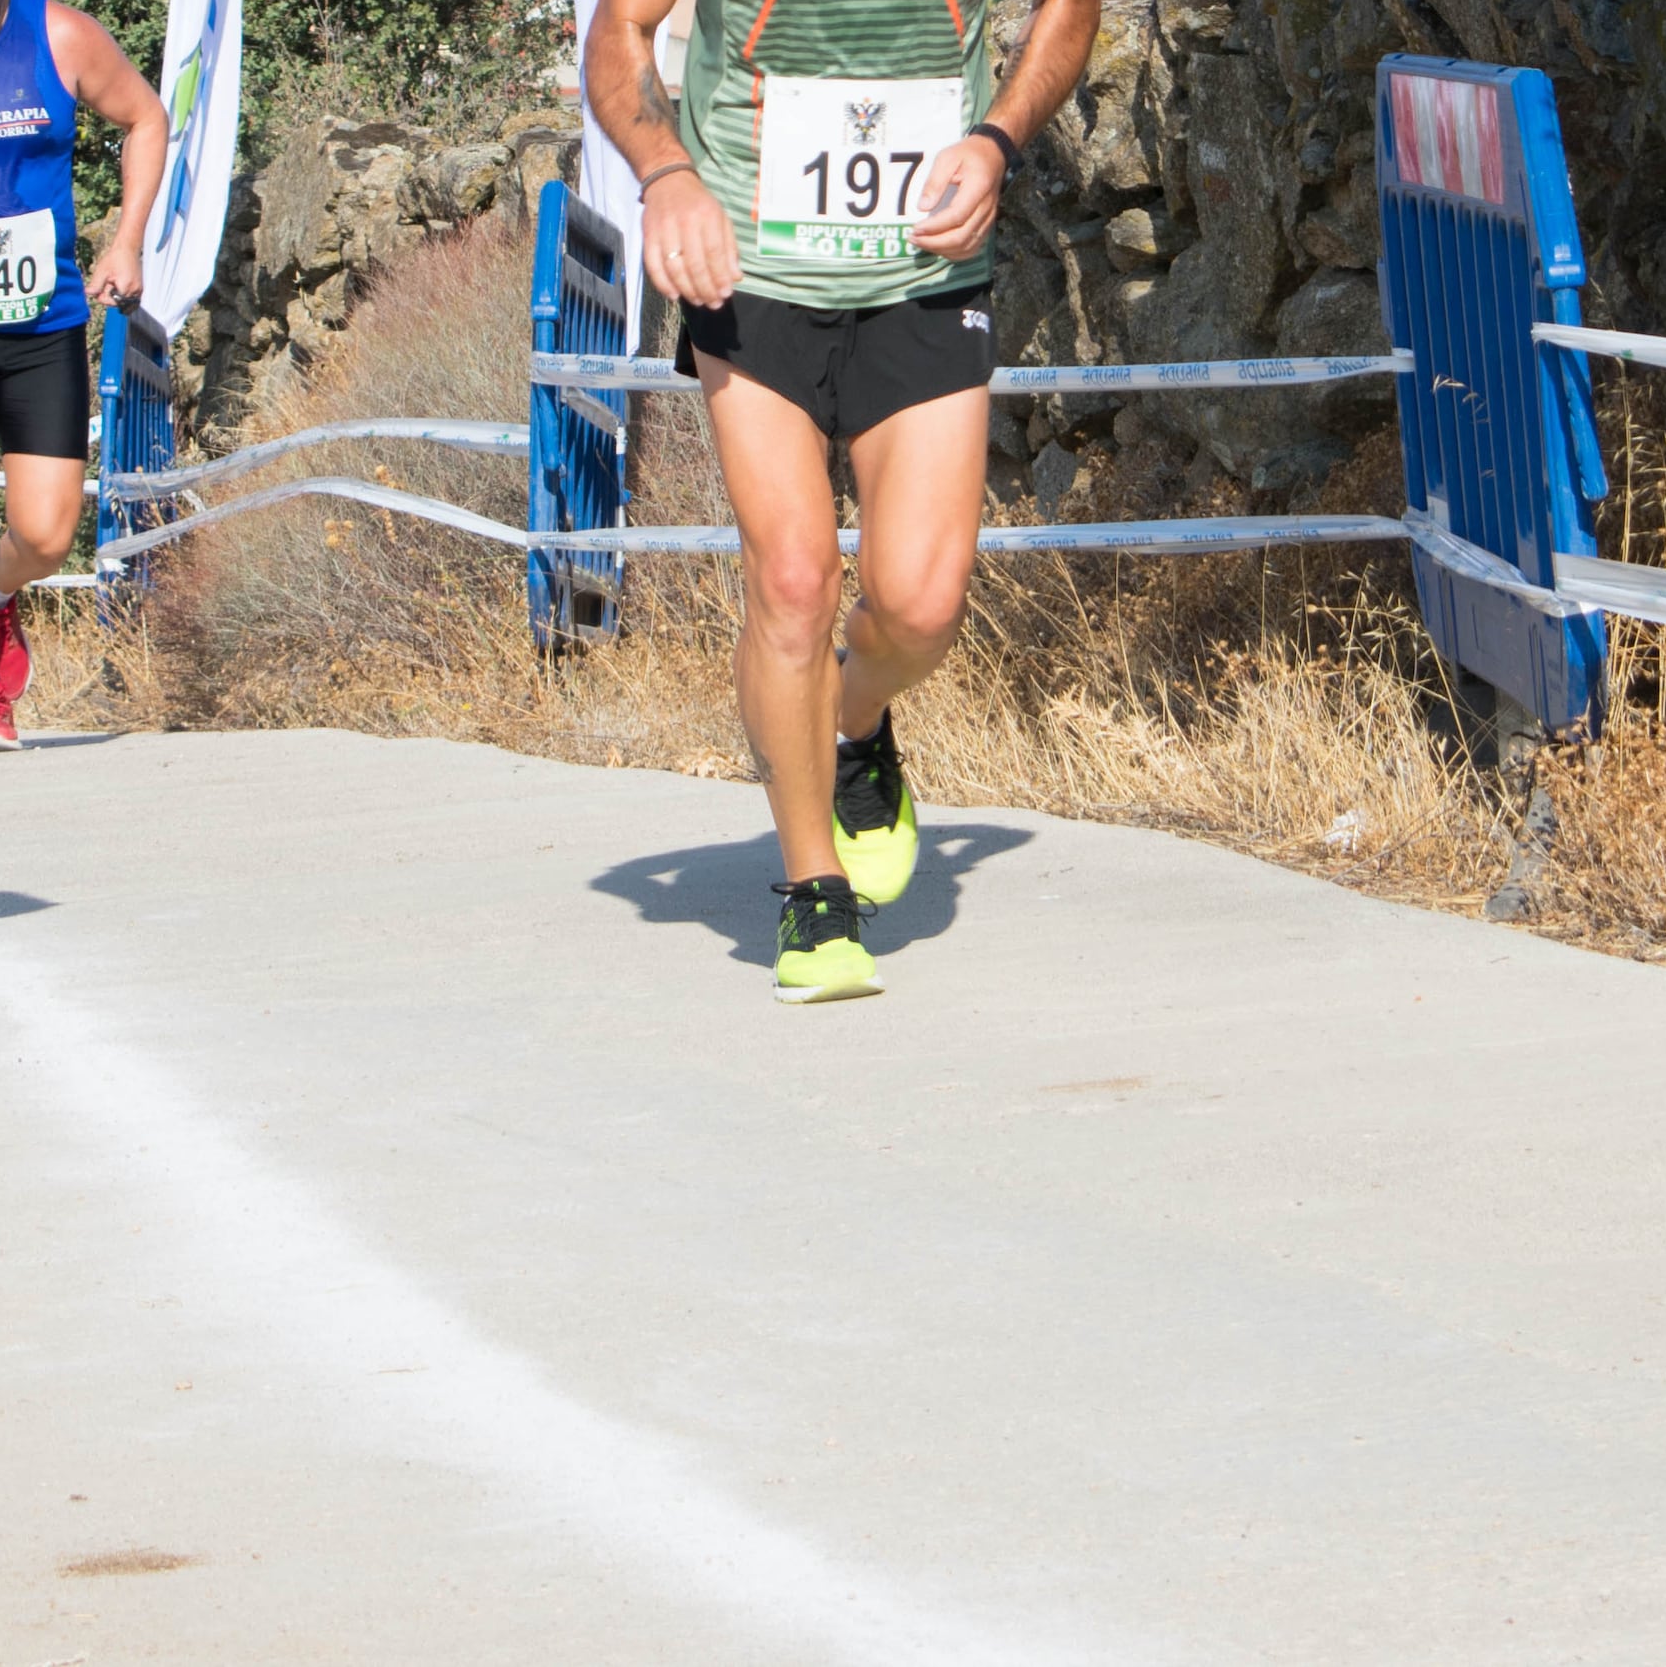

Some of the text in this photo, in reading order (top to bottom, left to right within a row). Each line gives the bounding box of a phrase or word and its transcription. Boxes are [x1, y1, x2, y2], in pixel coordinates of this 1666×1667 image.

[803, 151, 924, 218] 197
[795, 224, 899, 239] DIPUTACIÓN
[1238, 360, 1296, 382] aqualia
